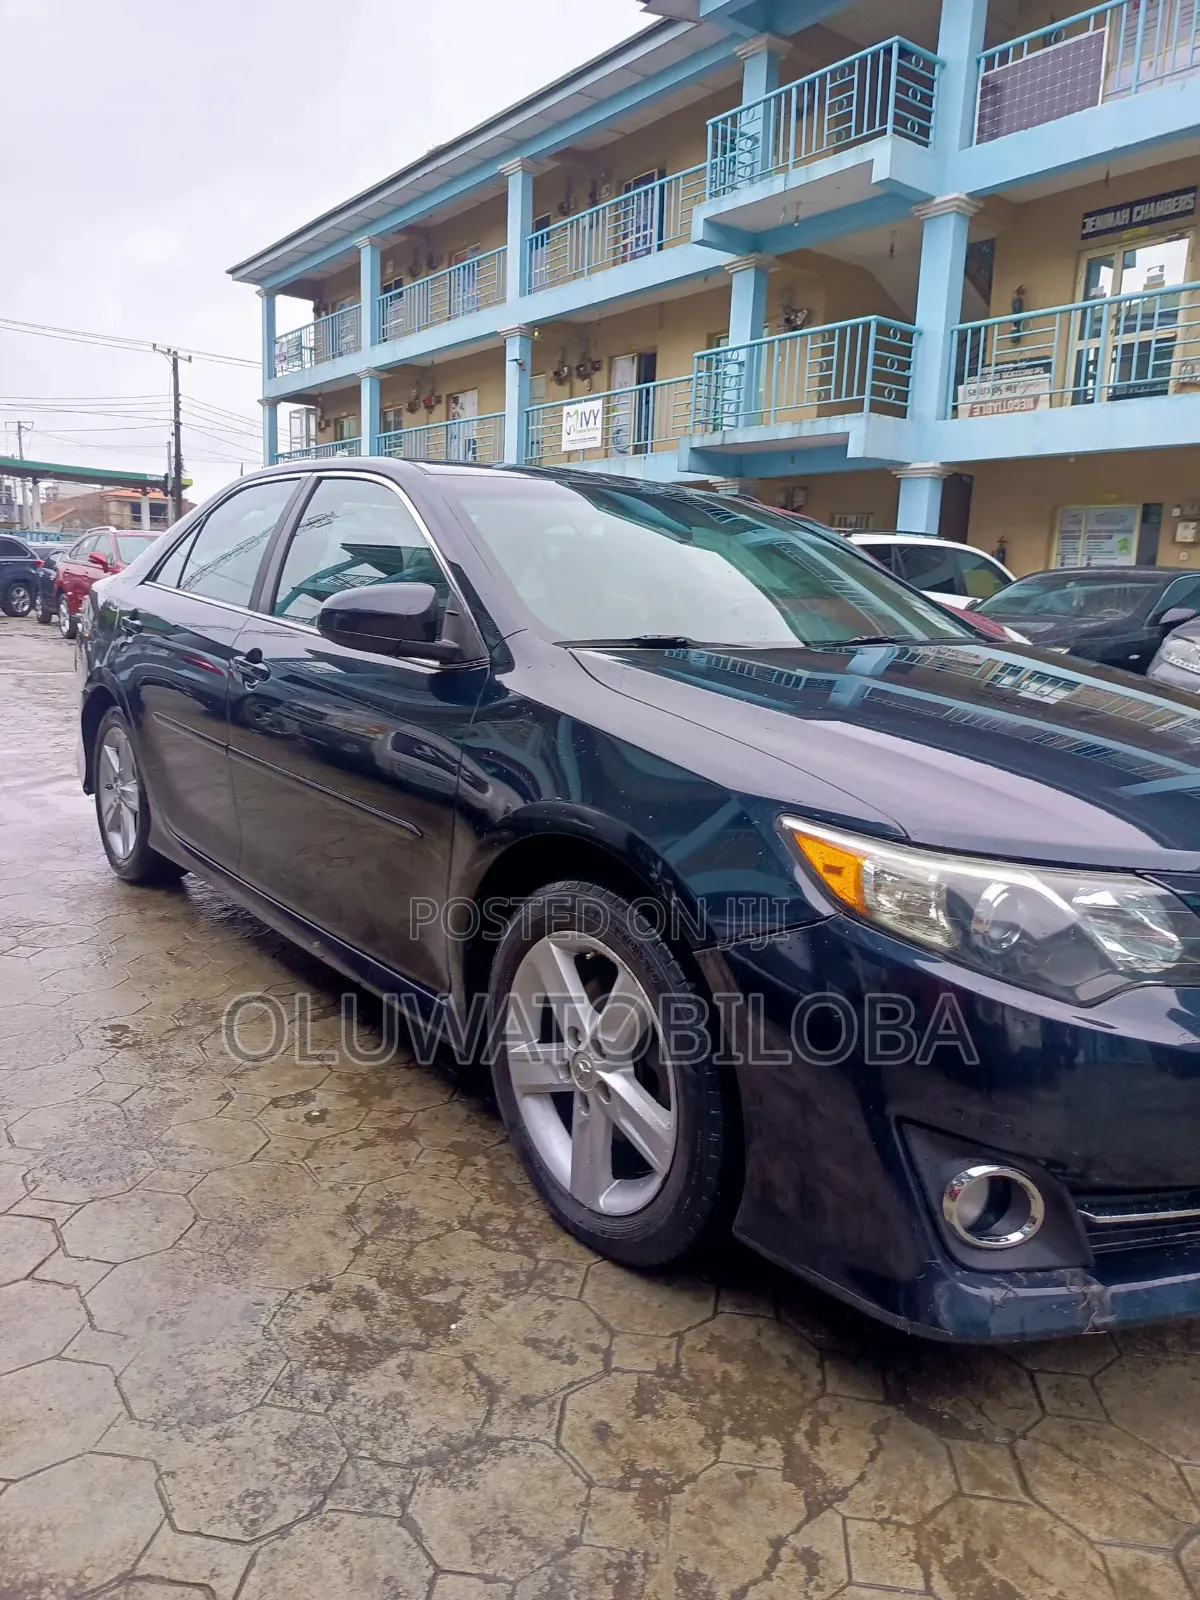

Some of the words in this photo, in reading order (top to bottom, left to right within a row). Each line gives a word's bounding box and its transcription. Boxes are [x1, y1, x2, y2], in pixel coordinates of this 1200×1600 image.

[1131, 193, 1194, 222] CHAMBERS
[973, 398, 1034, 415] NEGOTIABLE
[580, 409, 599, 427] IVY
